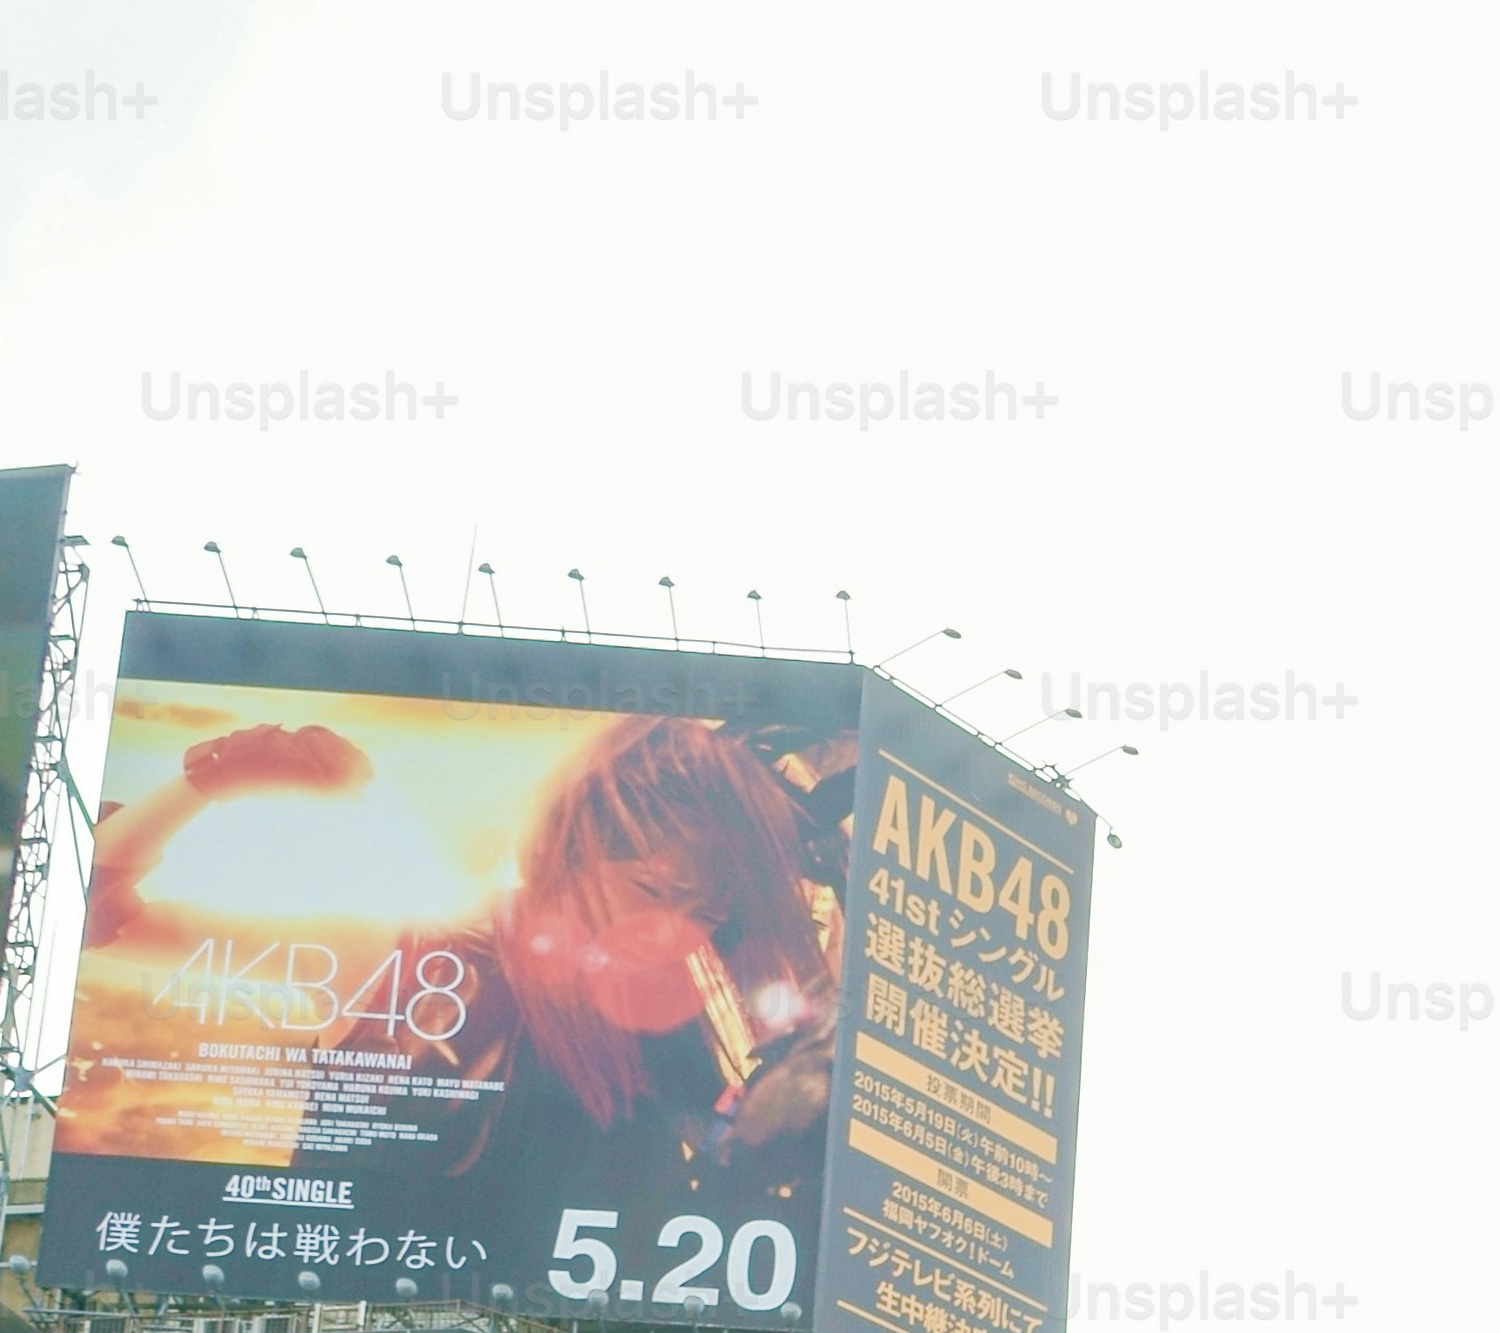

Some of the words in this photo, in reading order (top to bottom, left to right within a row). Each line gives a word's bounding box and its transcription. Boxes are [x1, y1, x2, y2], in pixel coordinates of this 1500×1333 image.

[872, 775, 1072, 961] AKB48
[868, 866, 942, 937] 41st
[948, 909, 1065, 1001] シングル
[153, 937, 467, 1041] AKB48
[864, 912, 1065, 1060] 選抜総選挙
[198, 1042, 281, 1062] BOKUTACHI
[285, 1049, 308, 1065] WA
[311, 1049, 412, 1071] TATAKAWANAI
[865, 973, 1055, 1118] 開催決定!!
[95, 1210, 487, 1271] 僕たちは戦わない
[273, 1178, 353, 1205] SINGLE
[546, 1209, 797, 1312] 5.20
